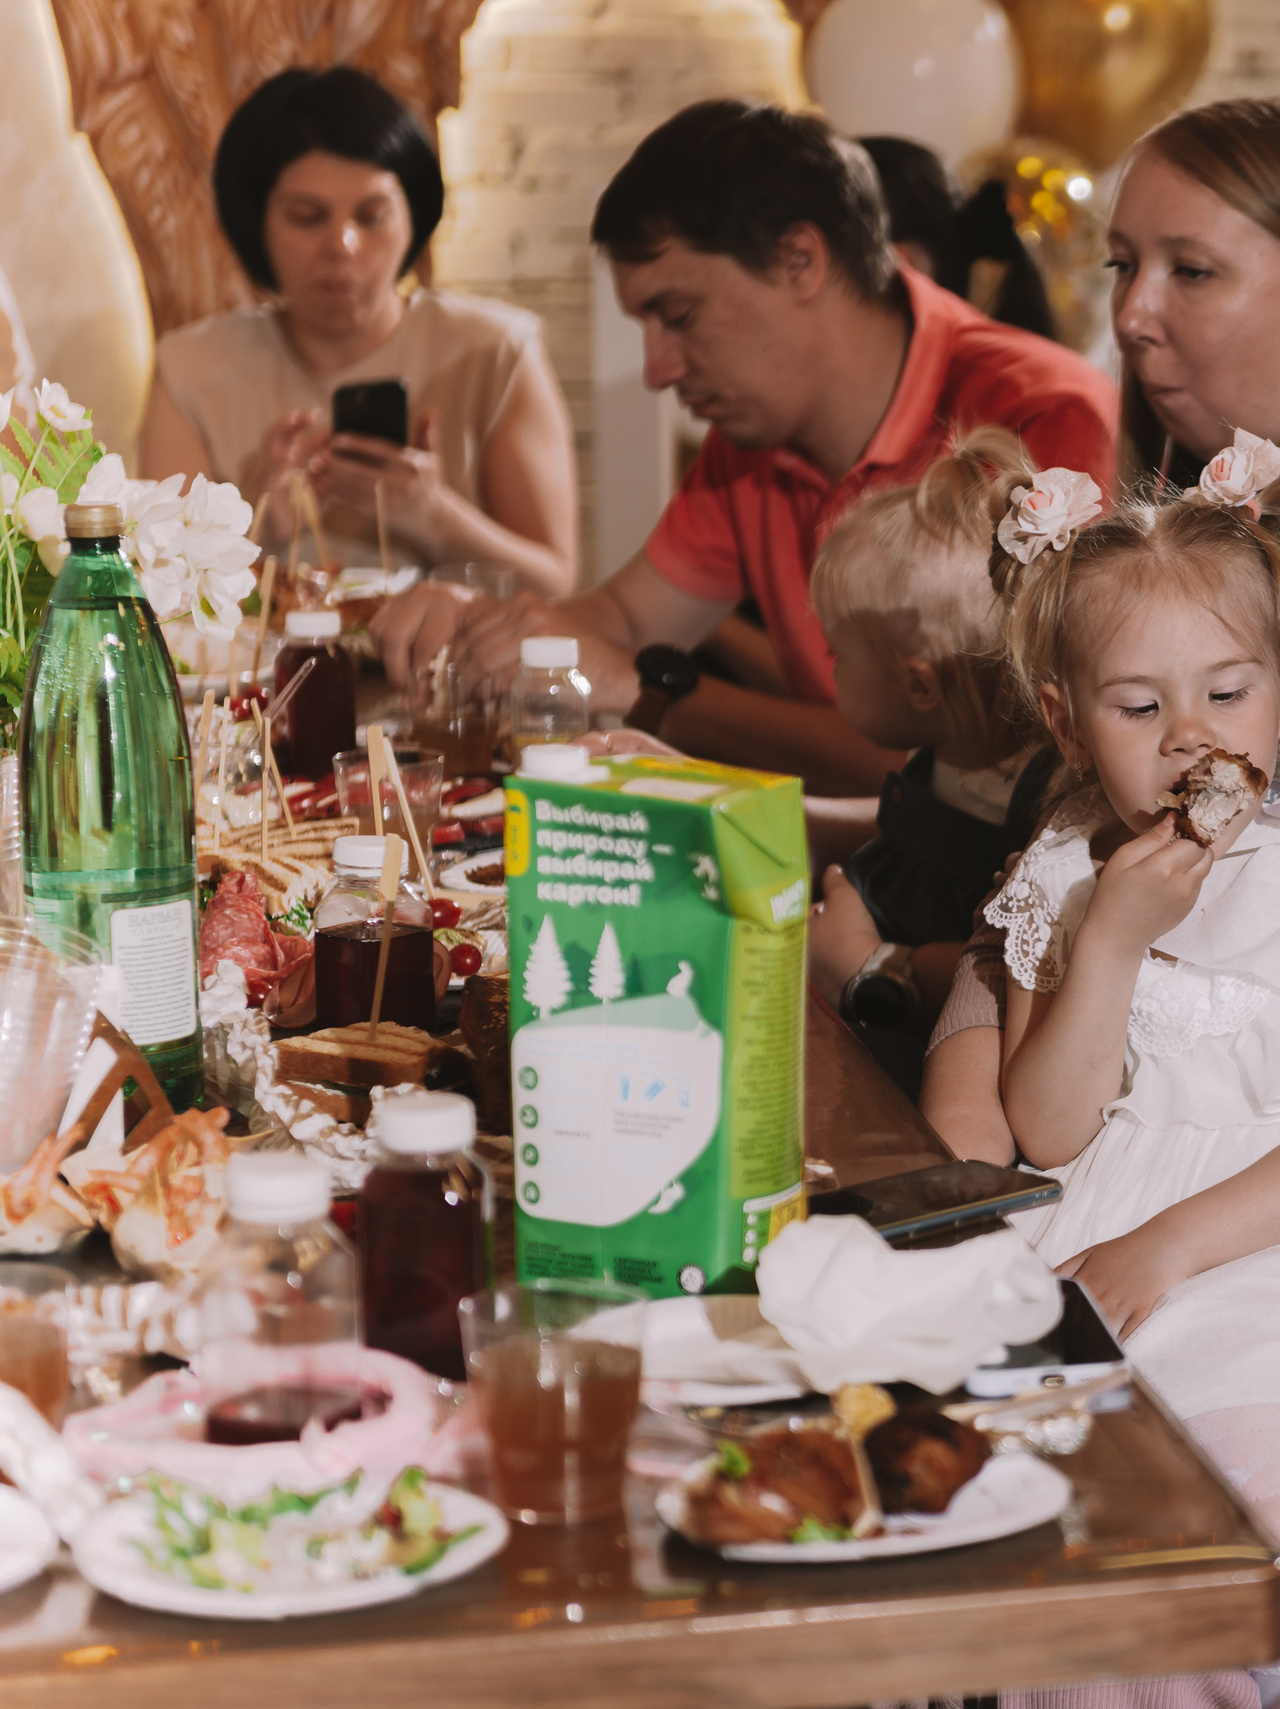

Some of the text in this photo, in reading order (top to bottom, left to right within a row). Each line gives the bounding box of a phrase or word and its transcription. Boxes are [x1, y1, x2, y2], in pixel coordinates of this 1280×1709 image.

[535, 799, 648, 832] Выбирай
[536, 829, 646, 858] природу
[537, 853, 654, 883] выбирай
[537, 882, 641, 908] картон!
